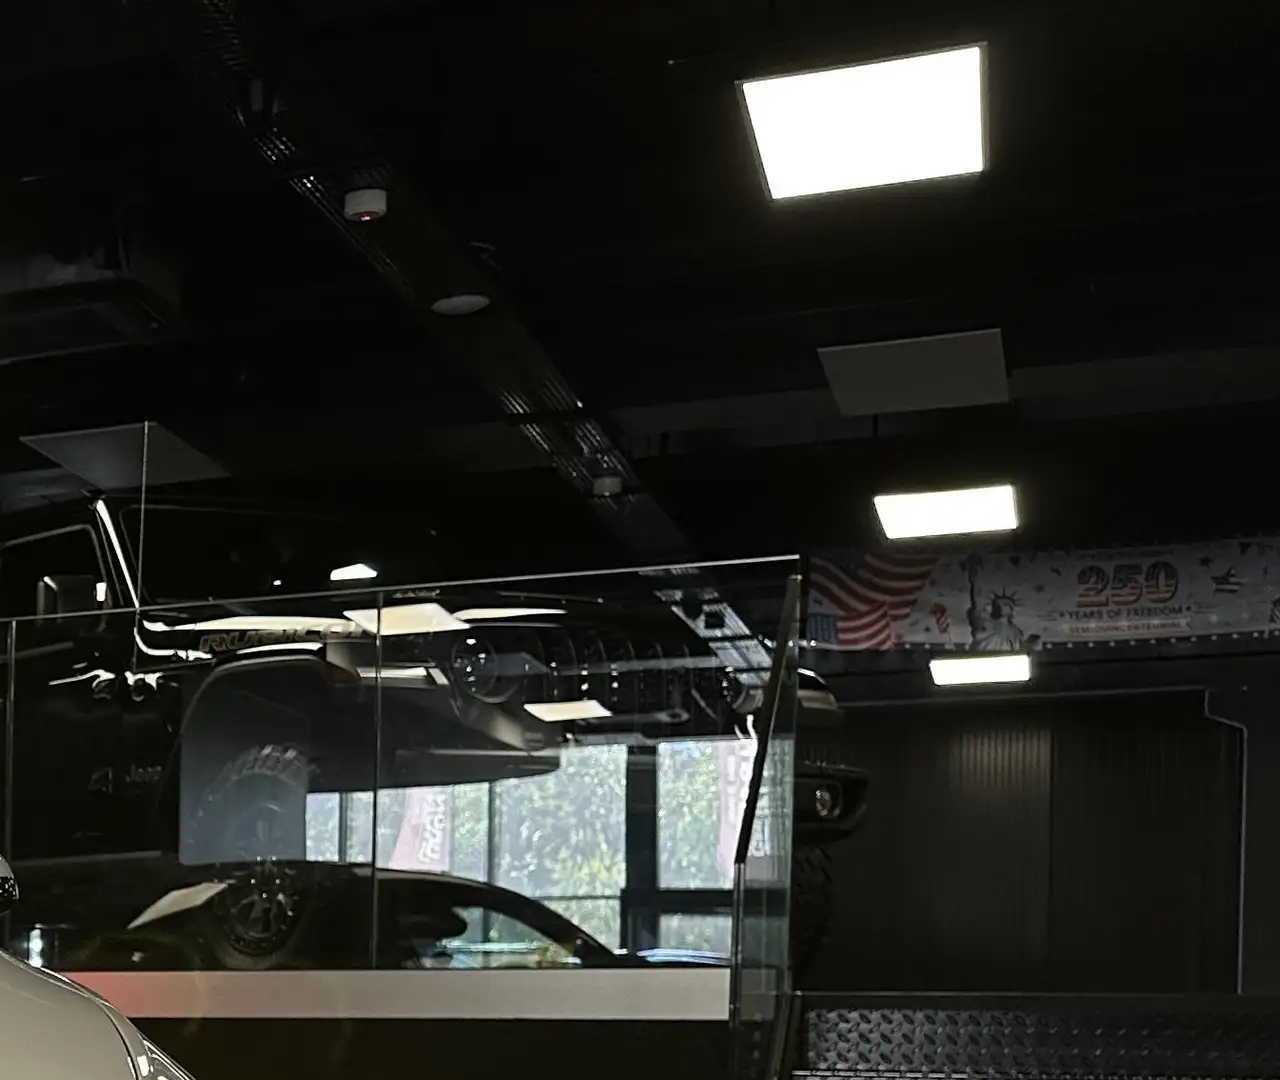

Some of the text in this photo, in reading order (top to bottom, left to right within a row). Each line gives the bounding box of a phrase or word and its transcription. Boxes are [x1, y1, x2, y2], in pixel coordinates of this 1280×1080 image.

[1077, 561, 1179, 607] 250
[1067, 606, 1183, 620] YEARS OF FREEDOM
